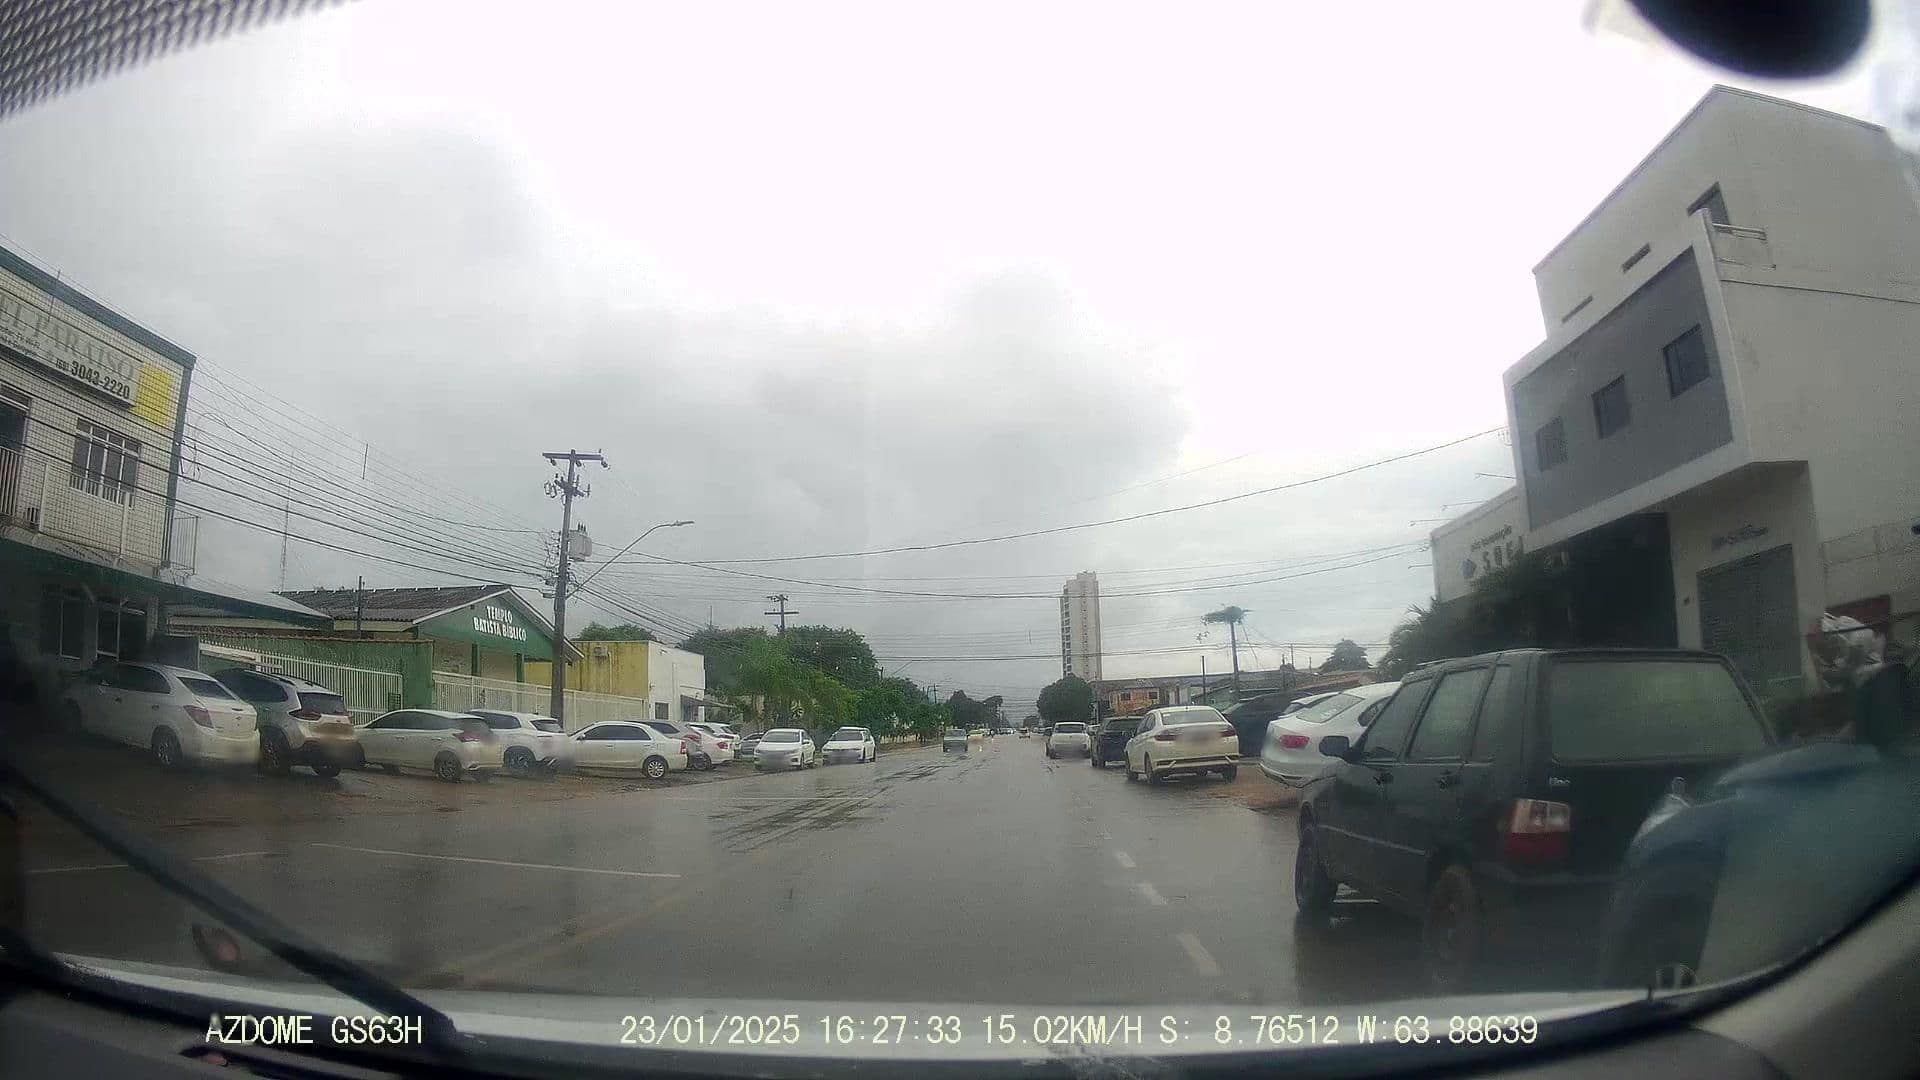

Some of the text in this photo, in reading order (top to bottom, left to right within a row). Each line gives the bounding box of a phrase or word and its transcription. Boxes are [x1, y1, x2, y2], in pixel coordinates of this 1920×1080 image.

[71, 360, 130, 400] 3043-2220
[486, 605, 513, 624] TEMPLO
[473, 616, 501, 637] BATISTA
